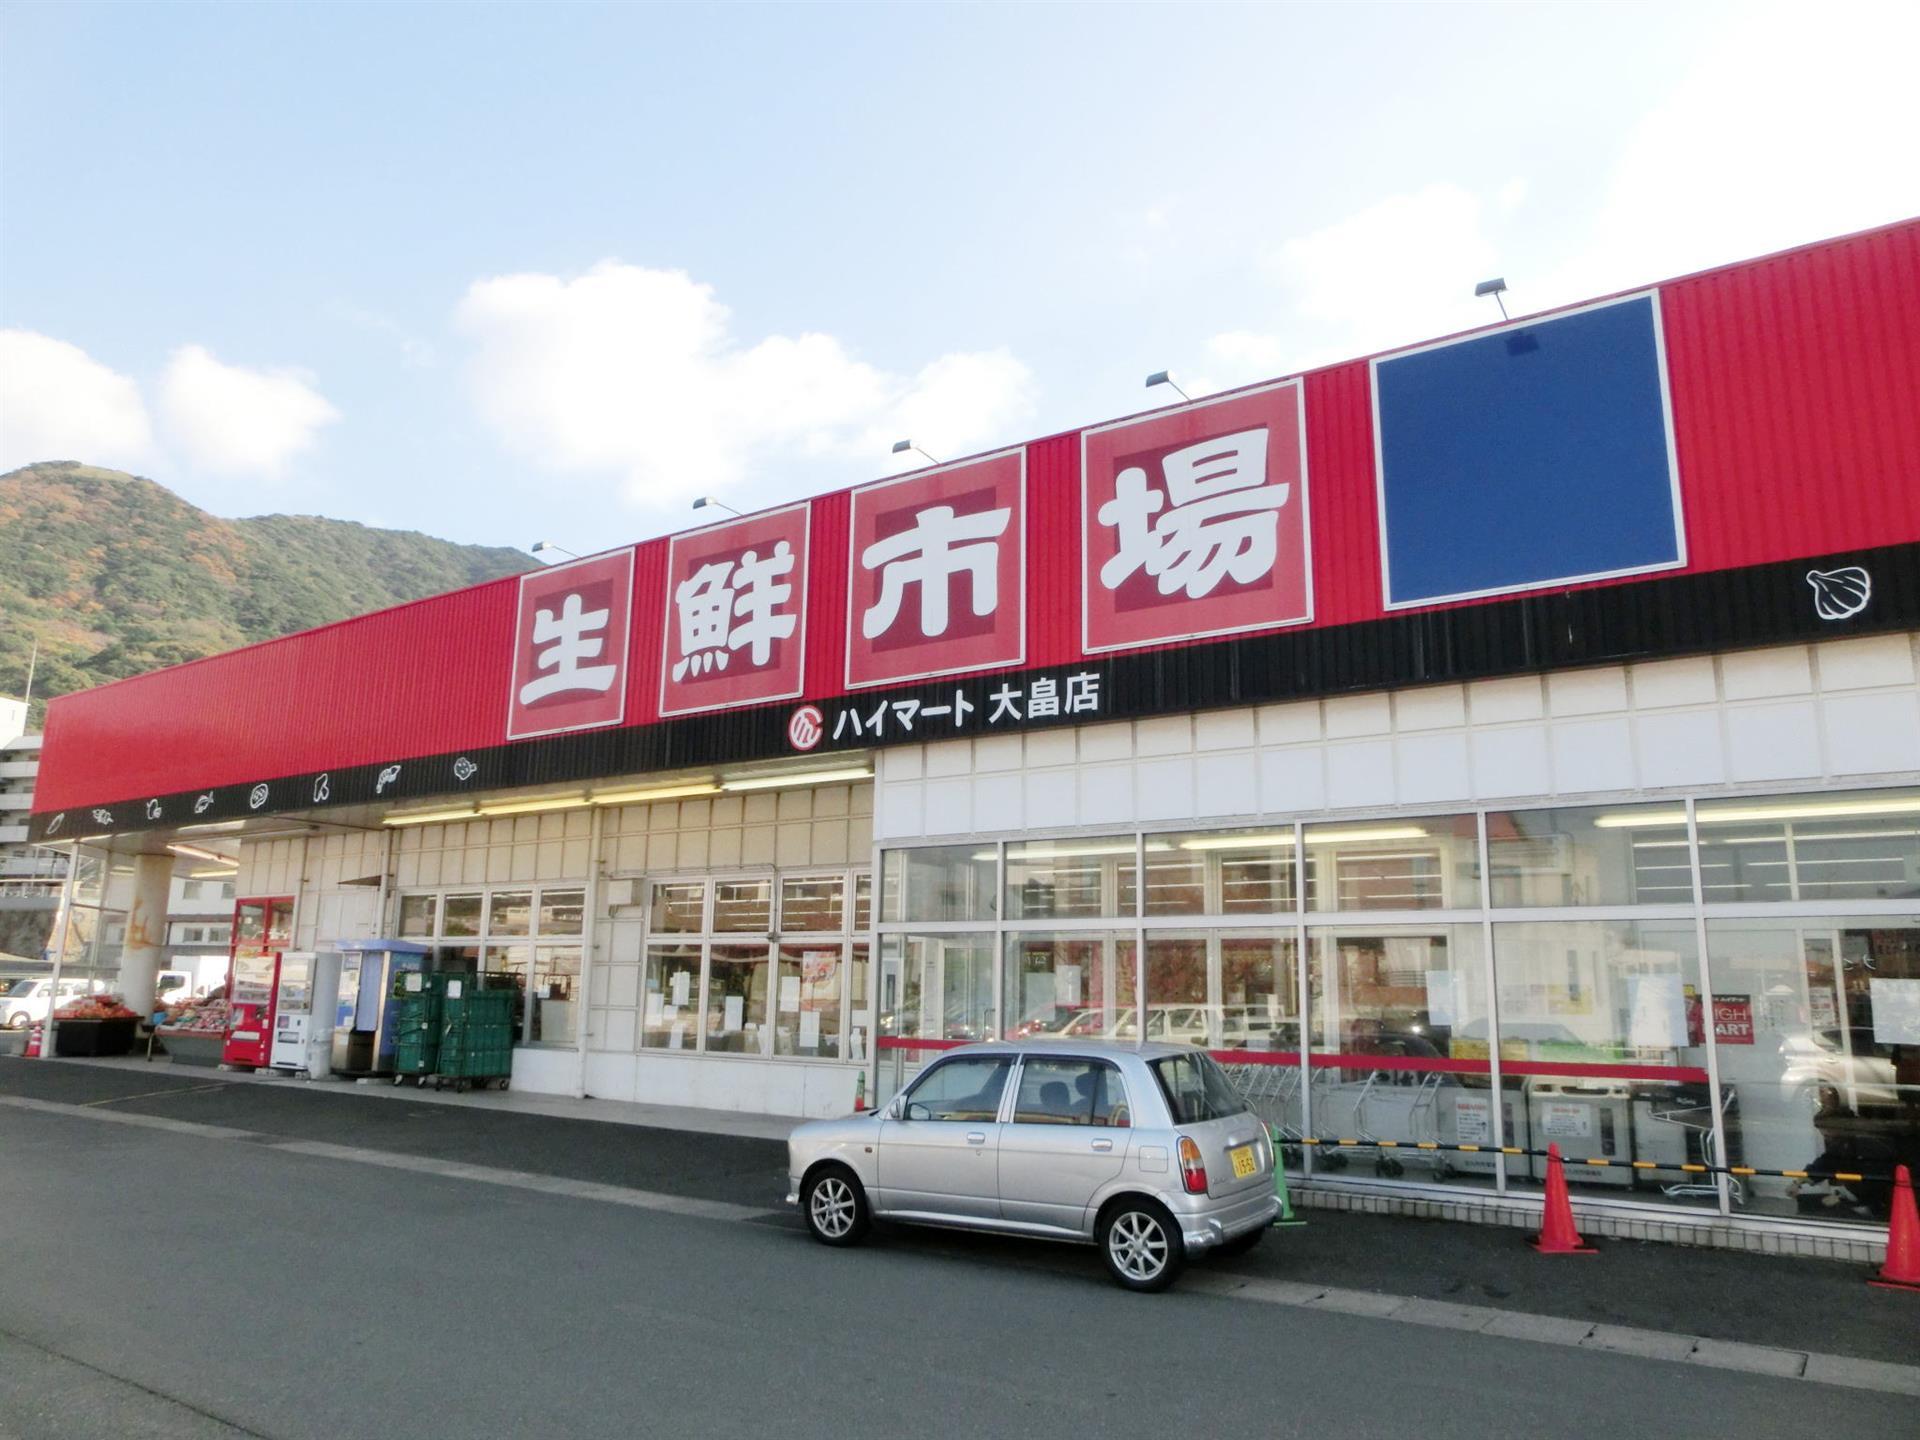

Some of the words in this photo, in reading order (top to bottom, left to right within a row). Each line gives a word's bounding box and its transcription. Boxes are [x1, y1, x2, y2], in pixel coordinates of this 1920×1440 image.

[519, 427, 1291, 706] 生鮮市場
[832, 689, 975, 741] ハイマート
[988, 672, 1101, 724] 大畠店
[1703, 1007, 1747, 1021] IGH
[1704, 1023, 1750, 1036] ART
